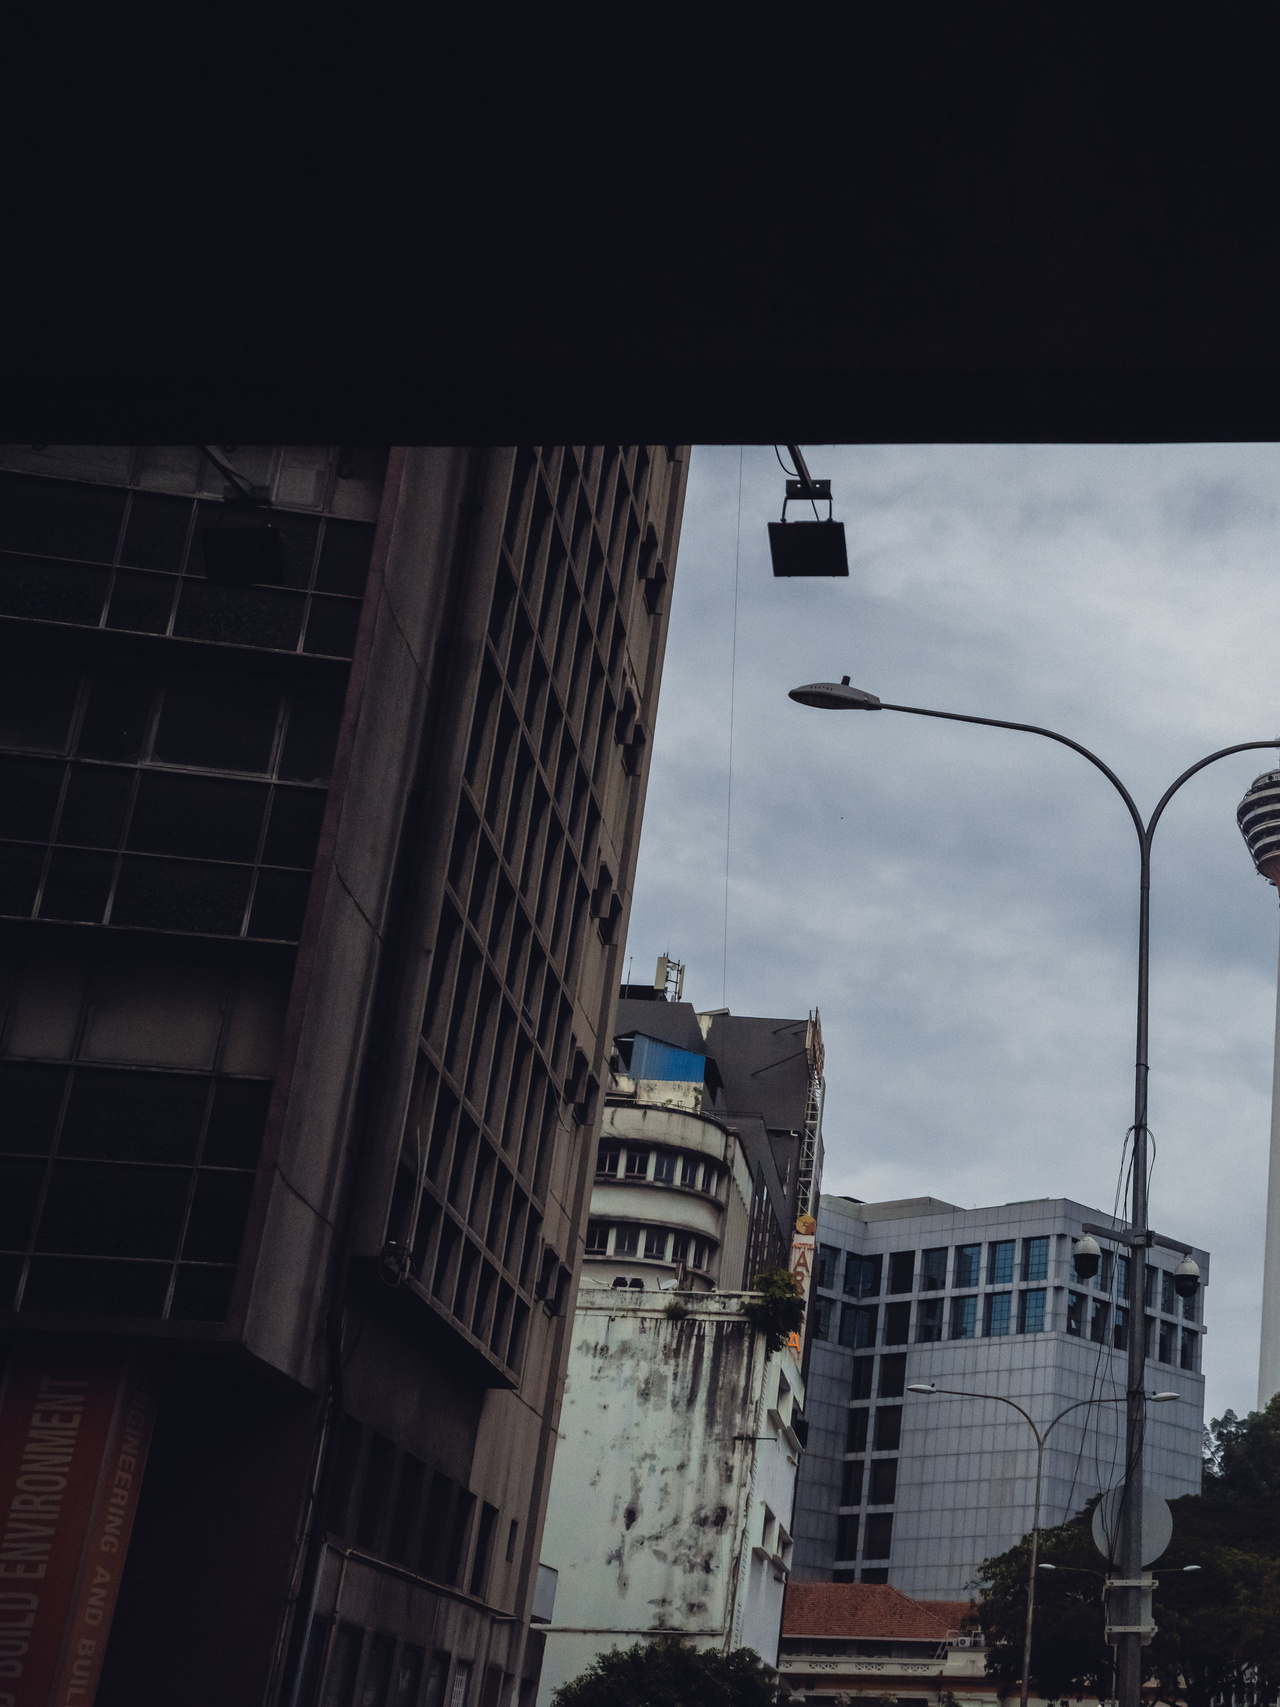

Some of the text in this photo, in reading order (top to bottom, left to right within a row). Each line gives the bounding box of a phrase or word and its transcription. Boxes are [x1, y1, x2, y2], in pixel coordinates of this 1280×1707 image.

[0, 1375, 90, 1579] ENVIRONMENT
[64, 1374, 152, 1707] ENGINEERING AND BUIL
